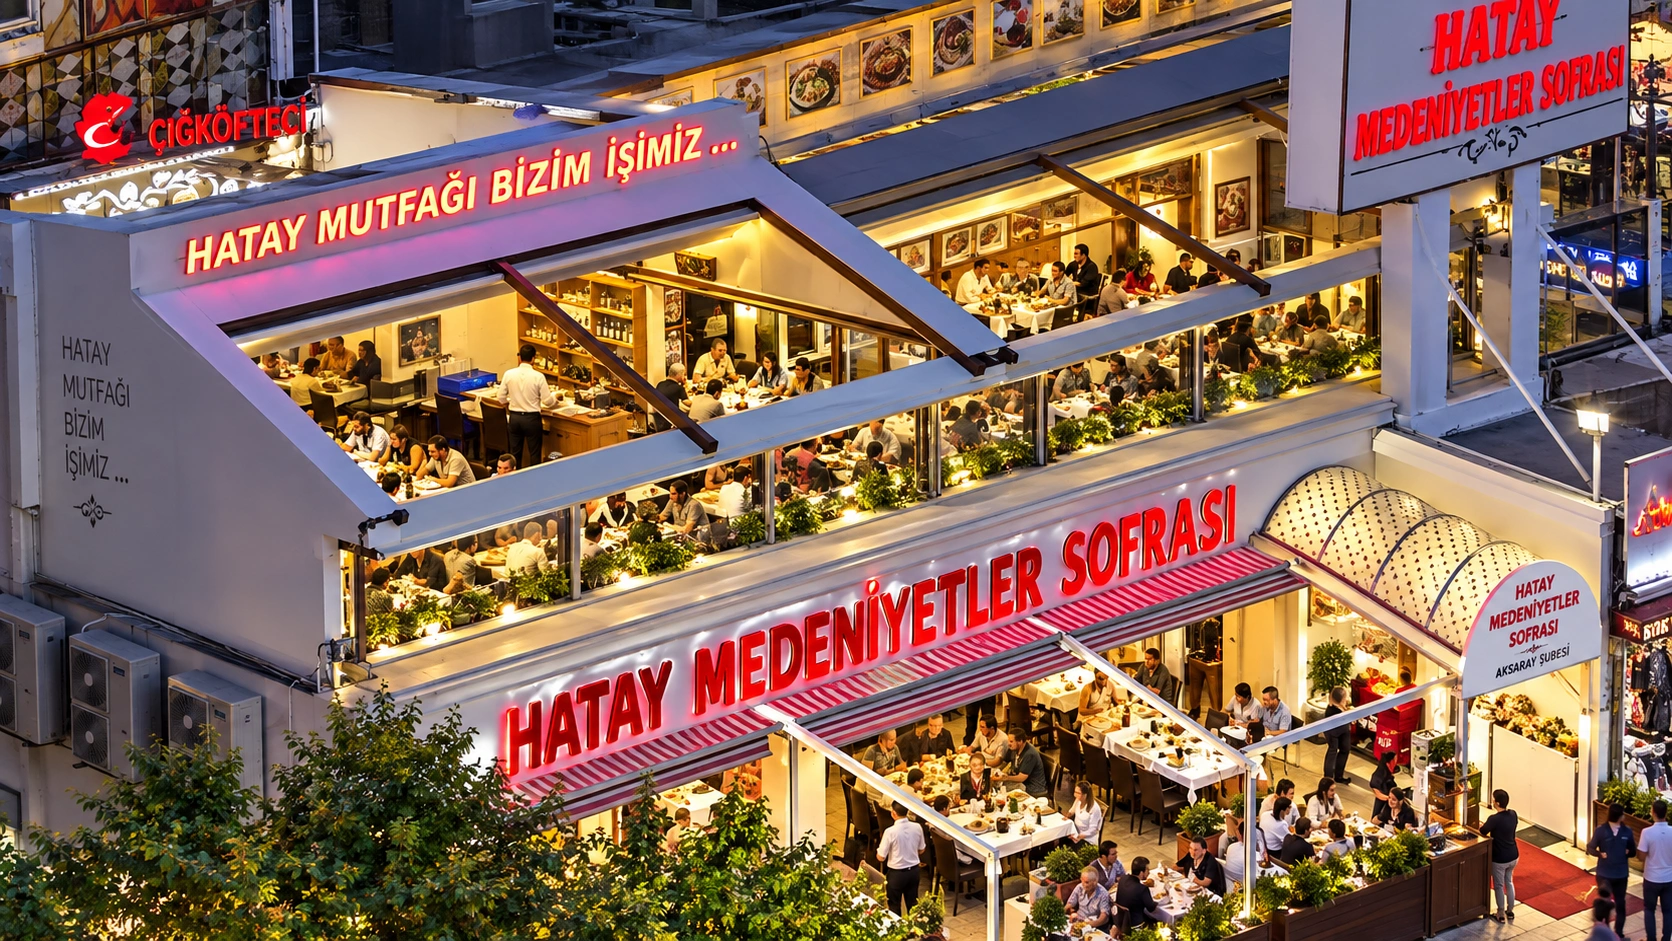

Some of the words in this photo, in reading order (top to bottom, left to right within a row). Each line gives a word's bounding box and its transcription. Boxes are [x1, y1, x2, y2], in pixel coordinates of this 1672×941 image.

[1431, 0, 1560, 75] HATAY
[1354, 71, 1535, 161] MEDENİYETLER
[1540, 45, 1625, 109] SOFRASI
[148, 96, 307, 156] ÇIĞKÖFTECİ
[185, 214, 307, 275] HATAY
[316, 171, 477, 245] MUTFAĞI
[490, 148, 591, 204] BİZİM
[604, 123, 703, 184] İŞİMİZ
[62, 335, 111, 366] HATAY
[63, 374, 130, 408] MUTFAĞI
[64, 407, 105, 441] BİZİM
[65, 444, 110, 481] İŞİMİZ
[1515, 574, 1555, 600] HATAY
[1489, 589, 1580, 631] MEDENİYETLER
[506, 660, 673, 776] HATAY
[694, 546, 1044, 715] MEDENİYETLER
[1060, 484, 1236, 596] SOFRASI
[1508, 619, 1559, 648] SOFRASI
[1495, 656, 1537, 678] AKSARAY
[1539, 642, 1570, 667] ŞUBESİ
